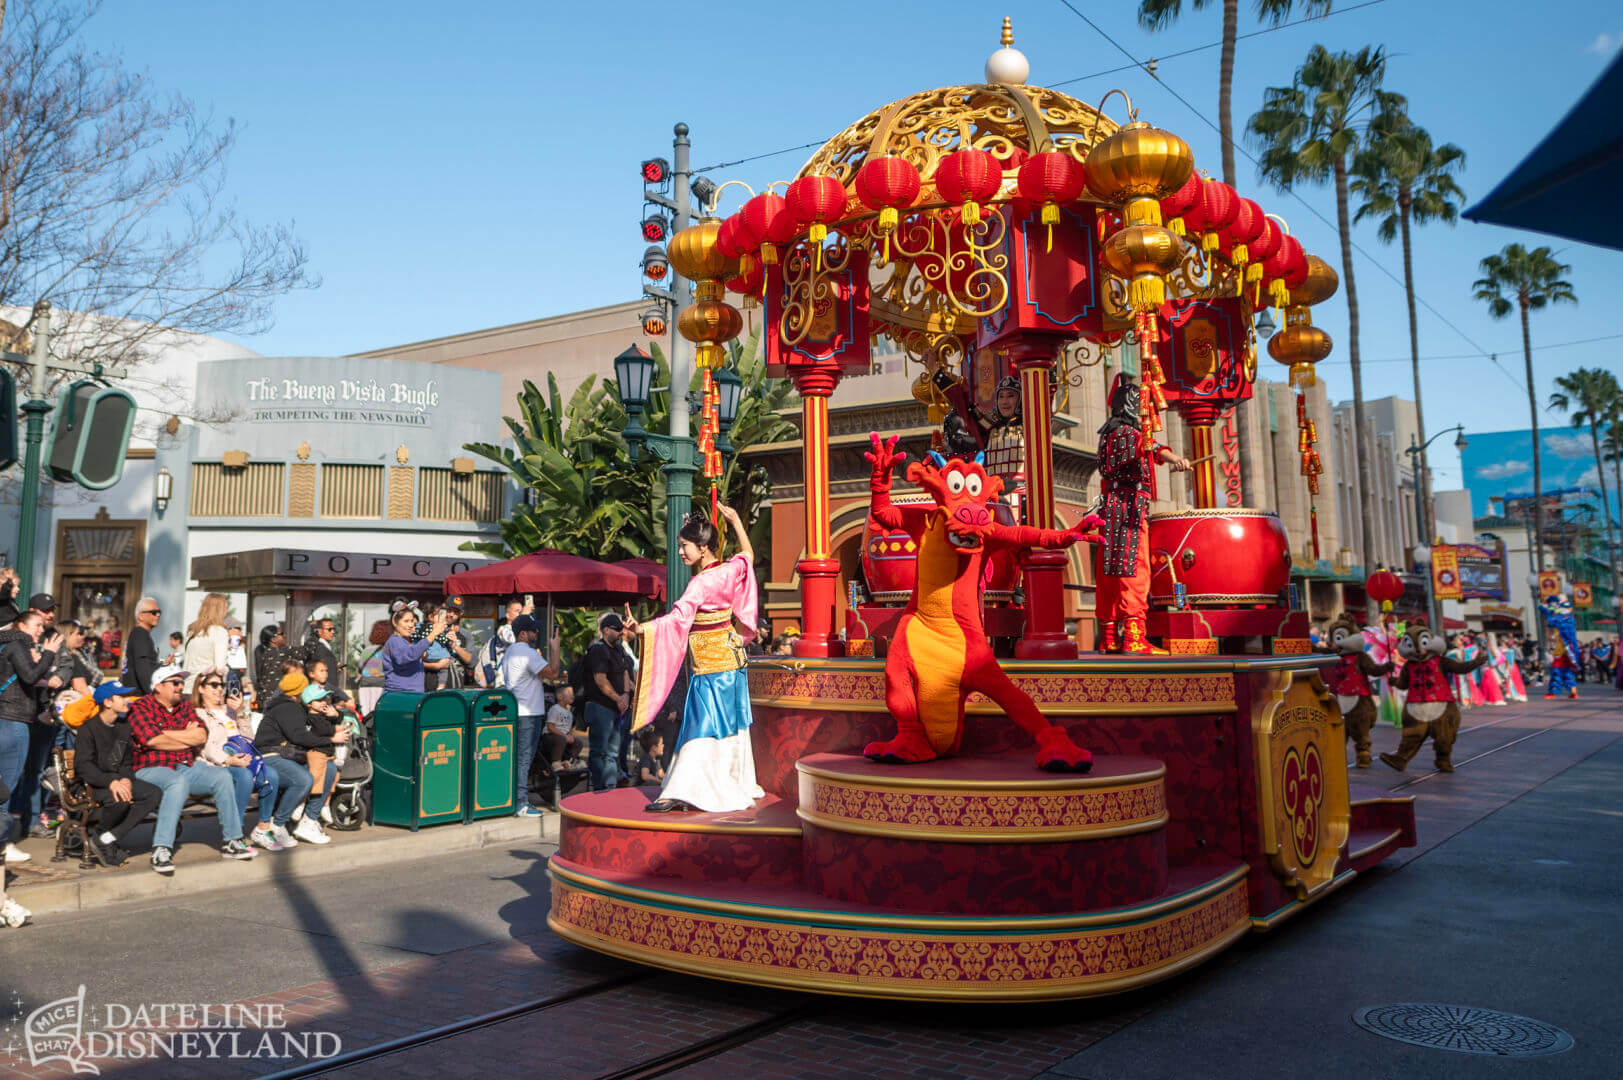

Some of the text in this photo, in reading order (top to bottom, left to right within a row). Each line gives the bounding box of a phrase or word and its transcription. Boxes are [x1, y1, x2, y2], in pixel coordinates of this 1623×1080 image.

[247, 376, 440, 416] The Buena Vista Bugle
[254, 410, 428, 426] TRUMPETING THE NEWS DAILY
[286, 554, 497, 576] POPCO
